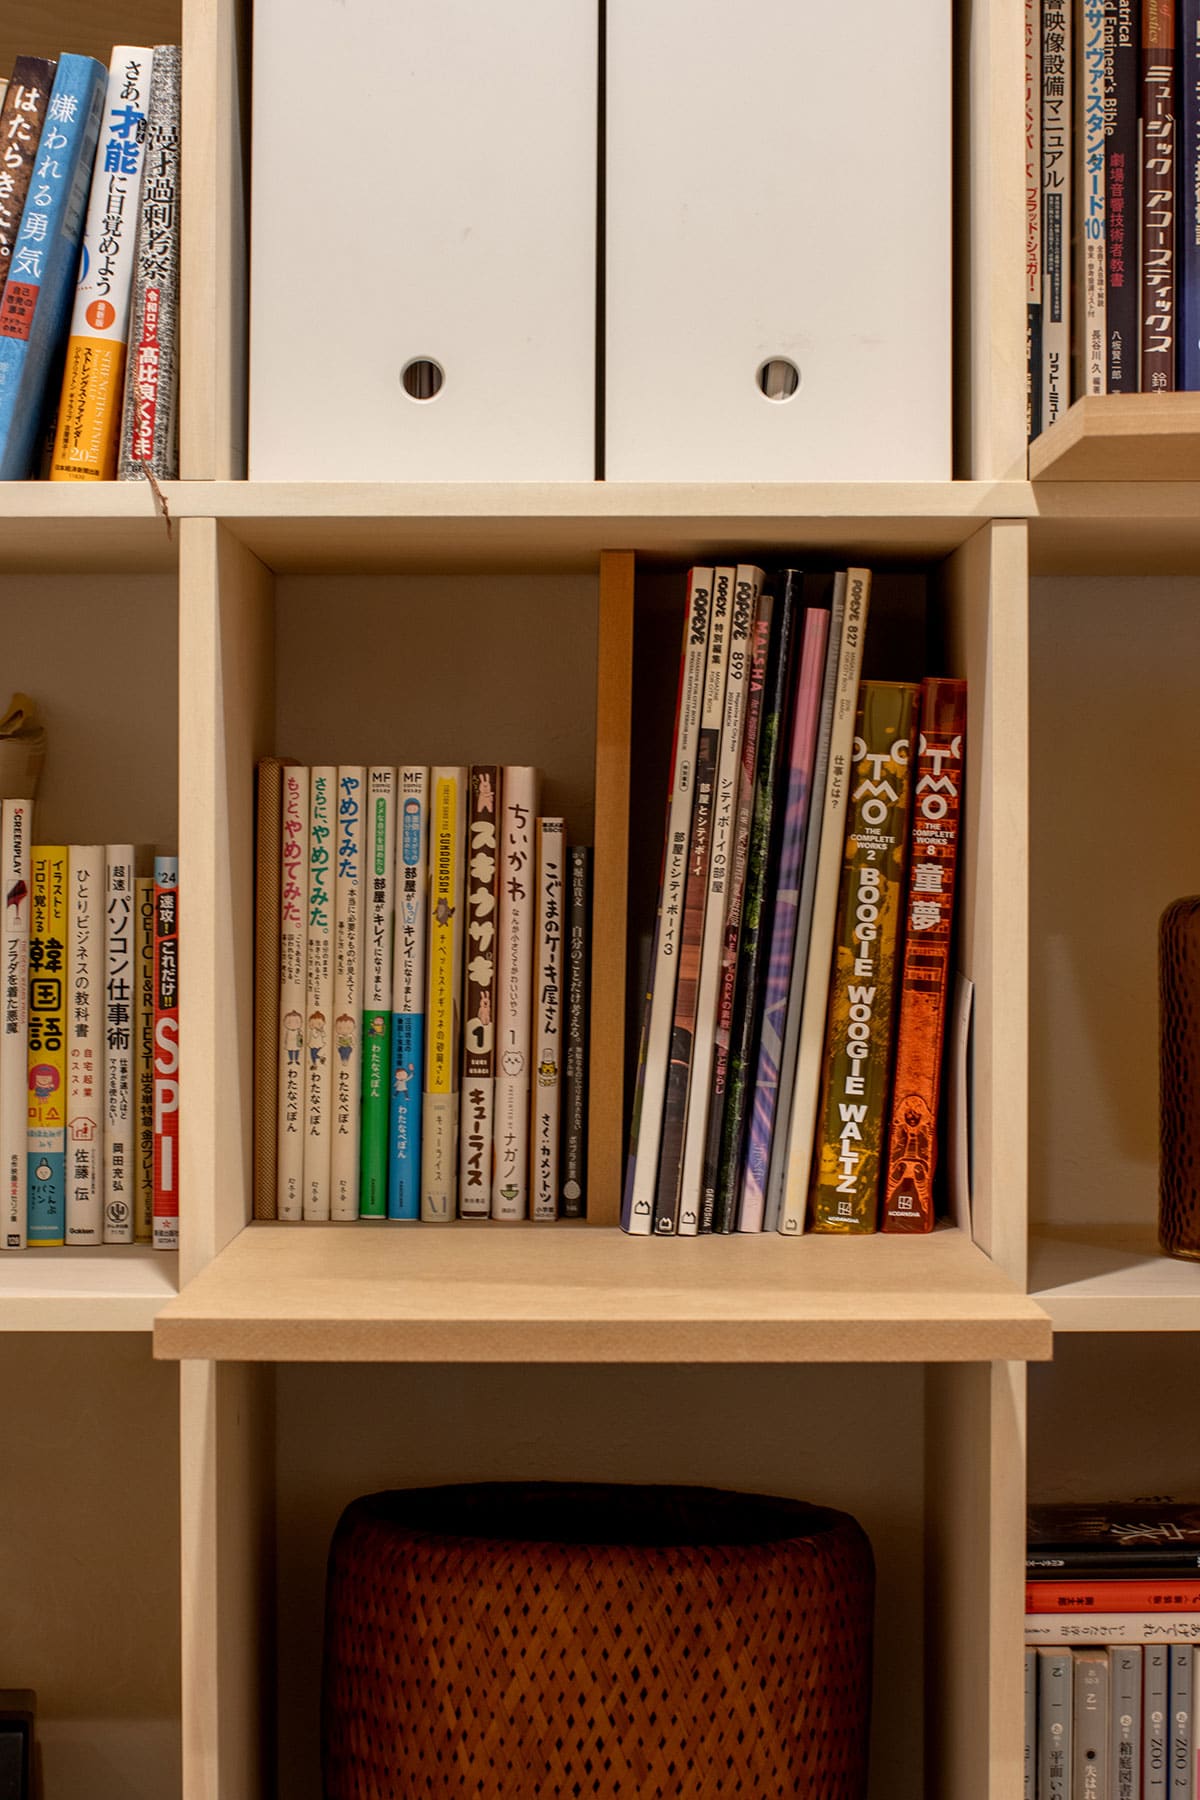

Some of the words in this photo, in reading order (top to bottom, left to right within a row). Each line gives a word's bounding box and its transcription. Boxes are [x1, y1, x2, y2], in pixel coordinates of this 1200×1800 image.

[1104, 17, 1118, 93] Engineer's
[1104, 98, 1118, 136] Bible
[1144, 65, 1174, 175] ミュージック
[0, 85, 40, 256] はたらき。
[13, 93, 78, 278] 嫌われる勇気
[97, 61, 145, 296] さあ、才能に目覚めよう
[139, 126, 178, 280] 漫才過剰考察
[1144, 190, 1173, 353] アコースティックス
[144, 290, 160, 343] 令和ロマン
[1049, 353, 1059, 427] リットーミュー
[690, 588, 709, 645] POPEYE
[714, 575, 728, 617] POPEYE
[732, 582, 753, 641] POPEYE
[848, 579, 863, 621] POPEYE
[750, 620, 769, 692] MAISHA
[845, 624, 858, 647] 827
[728, 651, 745, 680] 899
[372, 772, 391, 783] MF
[403, 772, 423, 783] MF
[831, 754, 844, 809] 仕事とは?
[13, 807, 25, 875] SCREENPLAY
[283, 777, 302, 929] もっと、やめてみた。
[310, 777, 330, 934] さらに、やめてみた。
[338, 777, 360, 886] やめてみた。
[507, 804, 529, 902] ちいかわ
[711, 778, 734, 893] シティボーイの部屋
[851, 833, 895, 843] COMPLETE
[856, 841, 888, 850] WORKS
[866, 850, 876, 861] 2
[912, 829, 954, 839] COMPLETE
[916, 837, 948, 846] WORKS
[926, 845, 936, 856] 8
[34, 859, 47, 932] ゴロで覚える
[52, 860, 64, 918] イラストと
[112, 865, 126, 891] 超速
[158, 872, 177, 884] '24
[663, 831, 686, 956] 部屋とシティボーイ3
[911, 863, 945, 931] 童夢
[140, 888, 154, 960] TOEIC
[159, 895, 176, 935] 速攻!
[372, 878, 387, 1001] 部屋がキレイになりました
[854, 868, 881, 977] BOOGIE
[74, 869, 91, 1038] ひとりビジネスの教科書
[107, 895, 132, 1050] パソコン仕事術
[160, 942, 177, 1007] これだけ!!
[542, 863, 561, 1034] こぐまのケーキ屋さん
[6, 939, 21, 1034] プラダを着た悪魔
[140, 1012, 154, 1070] TEST
[472, 1026, 484, 1048] 1
[509, 1030, 516, 1045] 1
[845, 986, 877, 1096] WOOGIE
[71, 1049, 80, 1096] のススメ
[83, 1049, 93, 1097] 自宅起業
[370, 1044, 381, 1097] わたなべぽん
[155, 1017, 179, 1192] SPI
[287, 1069, 298, 1132] わたなべぽん
[310, 1072, 321, 1136] わたなべぽん
[338, 1072, 349, 1134] わたなべぽん
[397, 1106, 407, 1159] わたなべぽん
[434, 1115, 442, 1181] キューライス
[467, 1089, 487, 1186] キューライス
[504, 1132, 518, 1178] ナガノ
[835, 1104, 868, 1193] WALTZ
[75, 1149, 89, 1180] 佐藤
[75, 1187, 89, 1201] 伝
[112, 1143, 124, 1192] 岡田充弘
[1119, 1742, 1133, 1800] 箱庭図書
[1151, 1738, 1163, 1770] ZOO
[1175, 1738, 1188, 1770] ZOO
